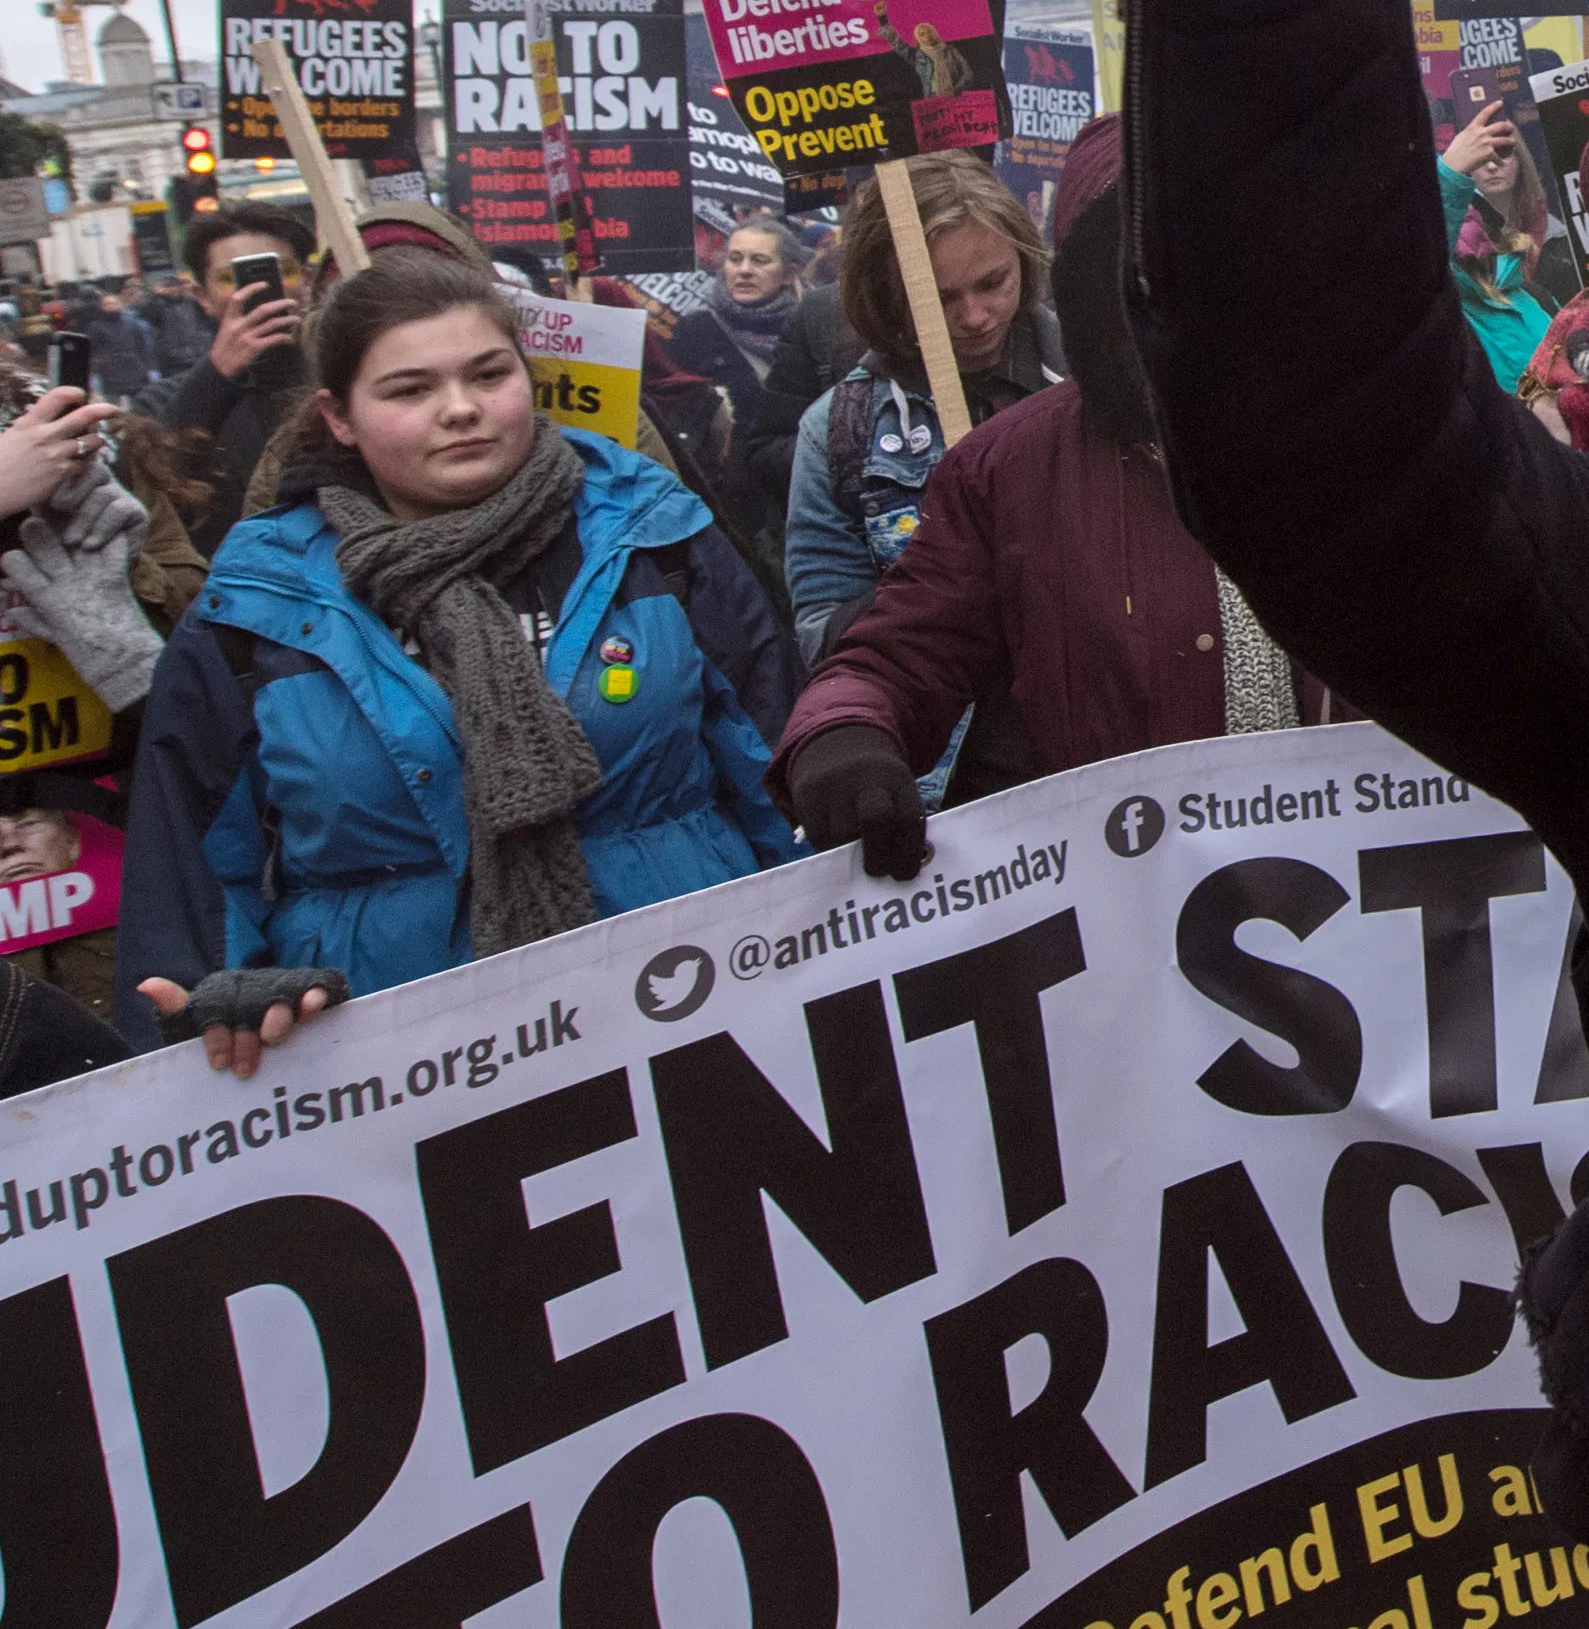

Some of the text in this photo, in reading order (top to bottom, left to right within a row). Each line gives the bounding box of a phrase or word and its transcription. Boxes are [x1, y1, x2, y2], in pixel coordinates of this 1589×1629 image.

[564, 21, 640, 75] TO
[727, 14, 870, 64] liberties
[224, 57, 406, 97] WCOME
[329, 99, 399, 117] borders
[745, 78, 876, 126] Oppose
[1007, 83, 1091, 116] REFUGEES
[687, 102, 717, 124] to
[243, 119, 269, 137] No
[756, 113, 889, 162] Prevent
[589, 145, 632, 165] and
[707, 151, 739, 174] to
[584, 170, 681, 188] welcome
[471, 199, 547, 218] Stamp
[544, 314, 573, 331] UP
[521, 331, 583, 354] ACISM
[730, 837, 1069, 982] @antiracismday
[1178, 779, 1342, 834] Student
[1354, 770, 1470, 814] Stand
[1356, 1453, 1464, 1564] EU
